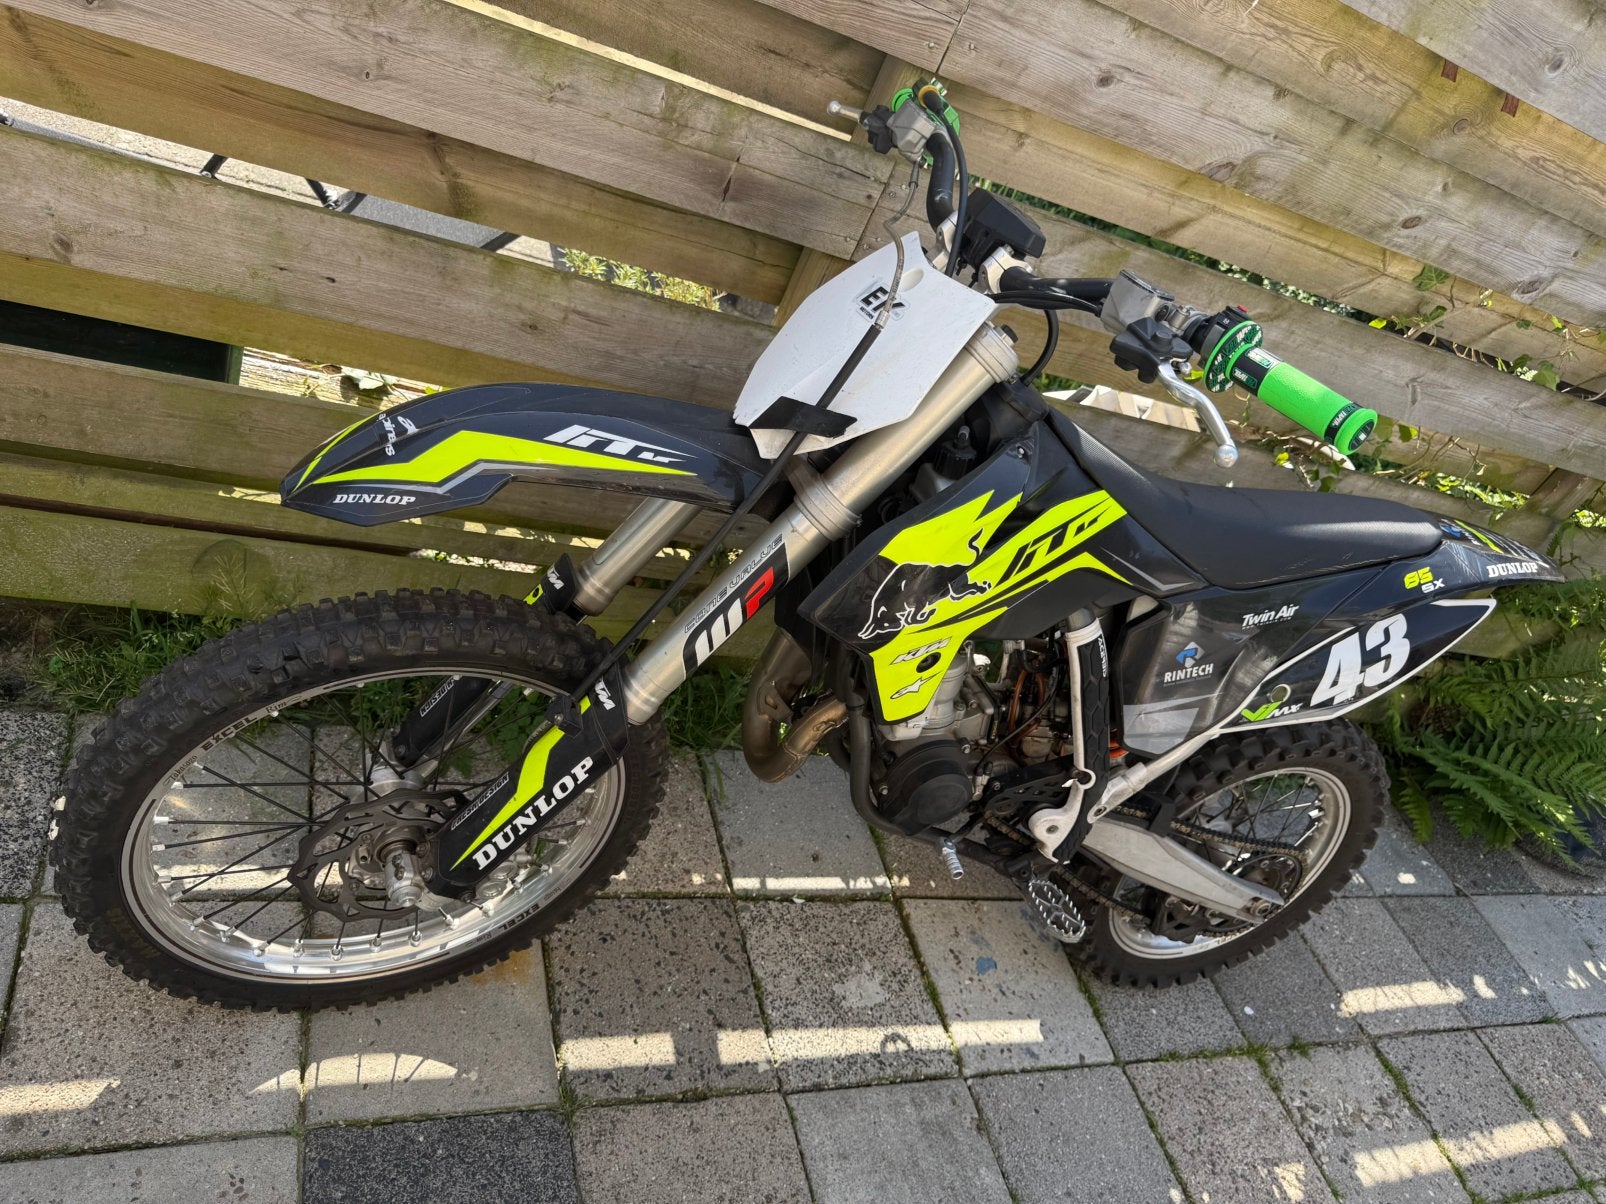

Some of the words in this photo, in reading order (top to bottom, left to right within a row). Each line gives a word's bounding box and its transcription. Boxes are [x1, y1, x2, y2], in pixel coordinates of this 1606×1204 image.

[332, 493, 416, 505] DUNLOP
[1486, 562, 1538, 577] DUNLOP
[1421, 578, 1446, 593] SX
[1242, 609, 1276, 627] Twin
[1275, 603, 1300, 619] Air
[1310, 613, 1411, 707] 43
[1163, 663, 1214, 683] RINTECH
[200, 717, 258, 752] EXCEL
[472, 756, 594, 870] DUNLOP
[498, 903, 540, 931] EXCEL
